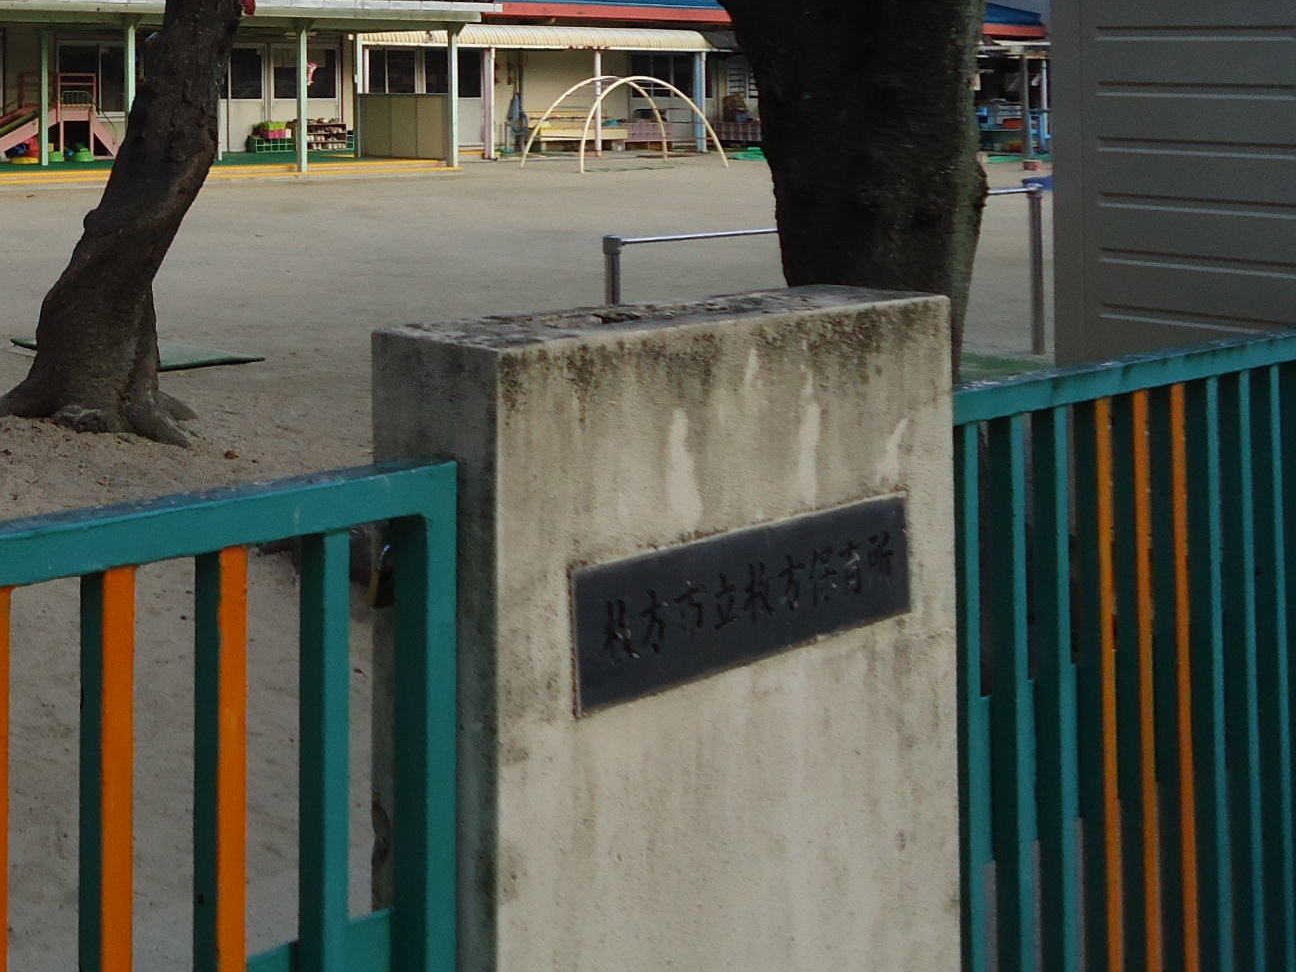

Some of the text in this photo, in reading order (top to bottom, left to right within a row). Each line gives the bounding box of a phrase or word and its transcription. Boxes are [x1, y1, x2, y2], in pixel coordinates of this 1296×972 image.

[601, 532, 896, 664] 枚方市立枚方保育所
